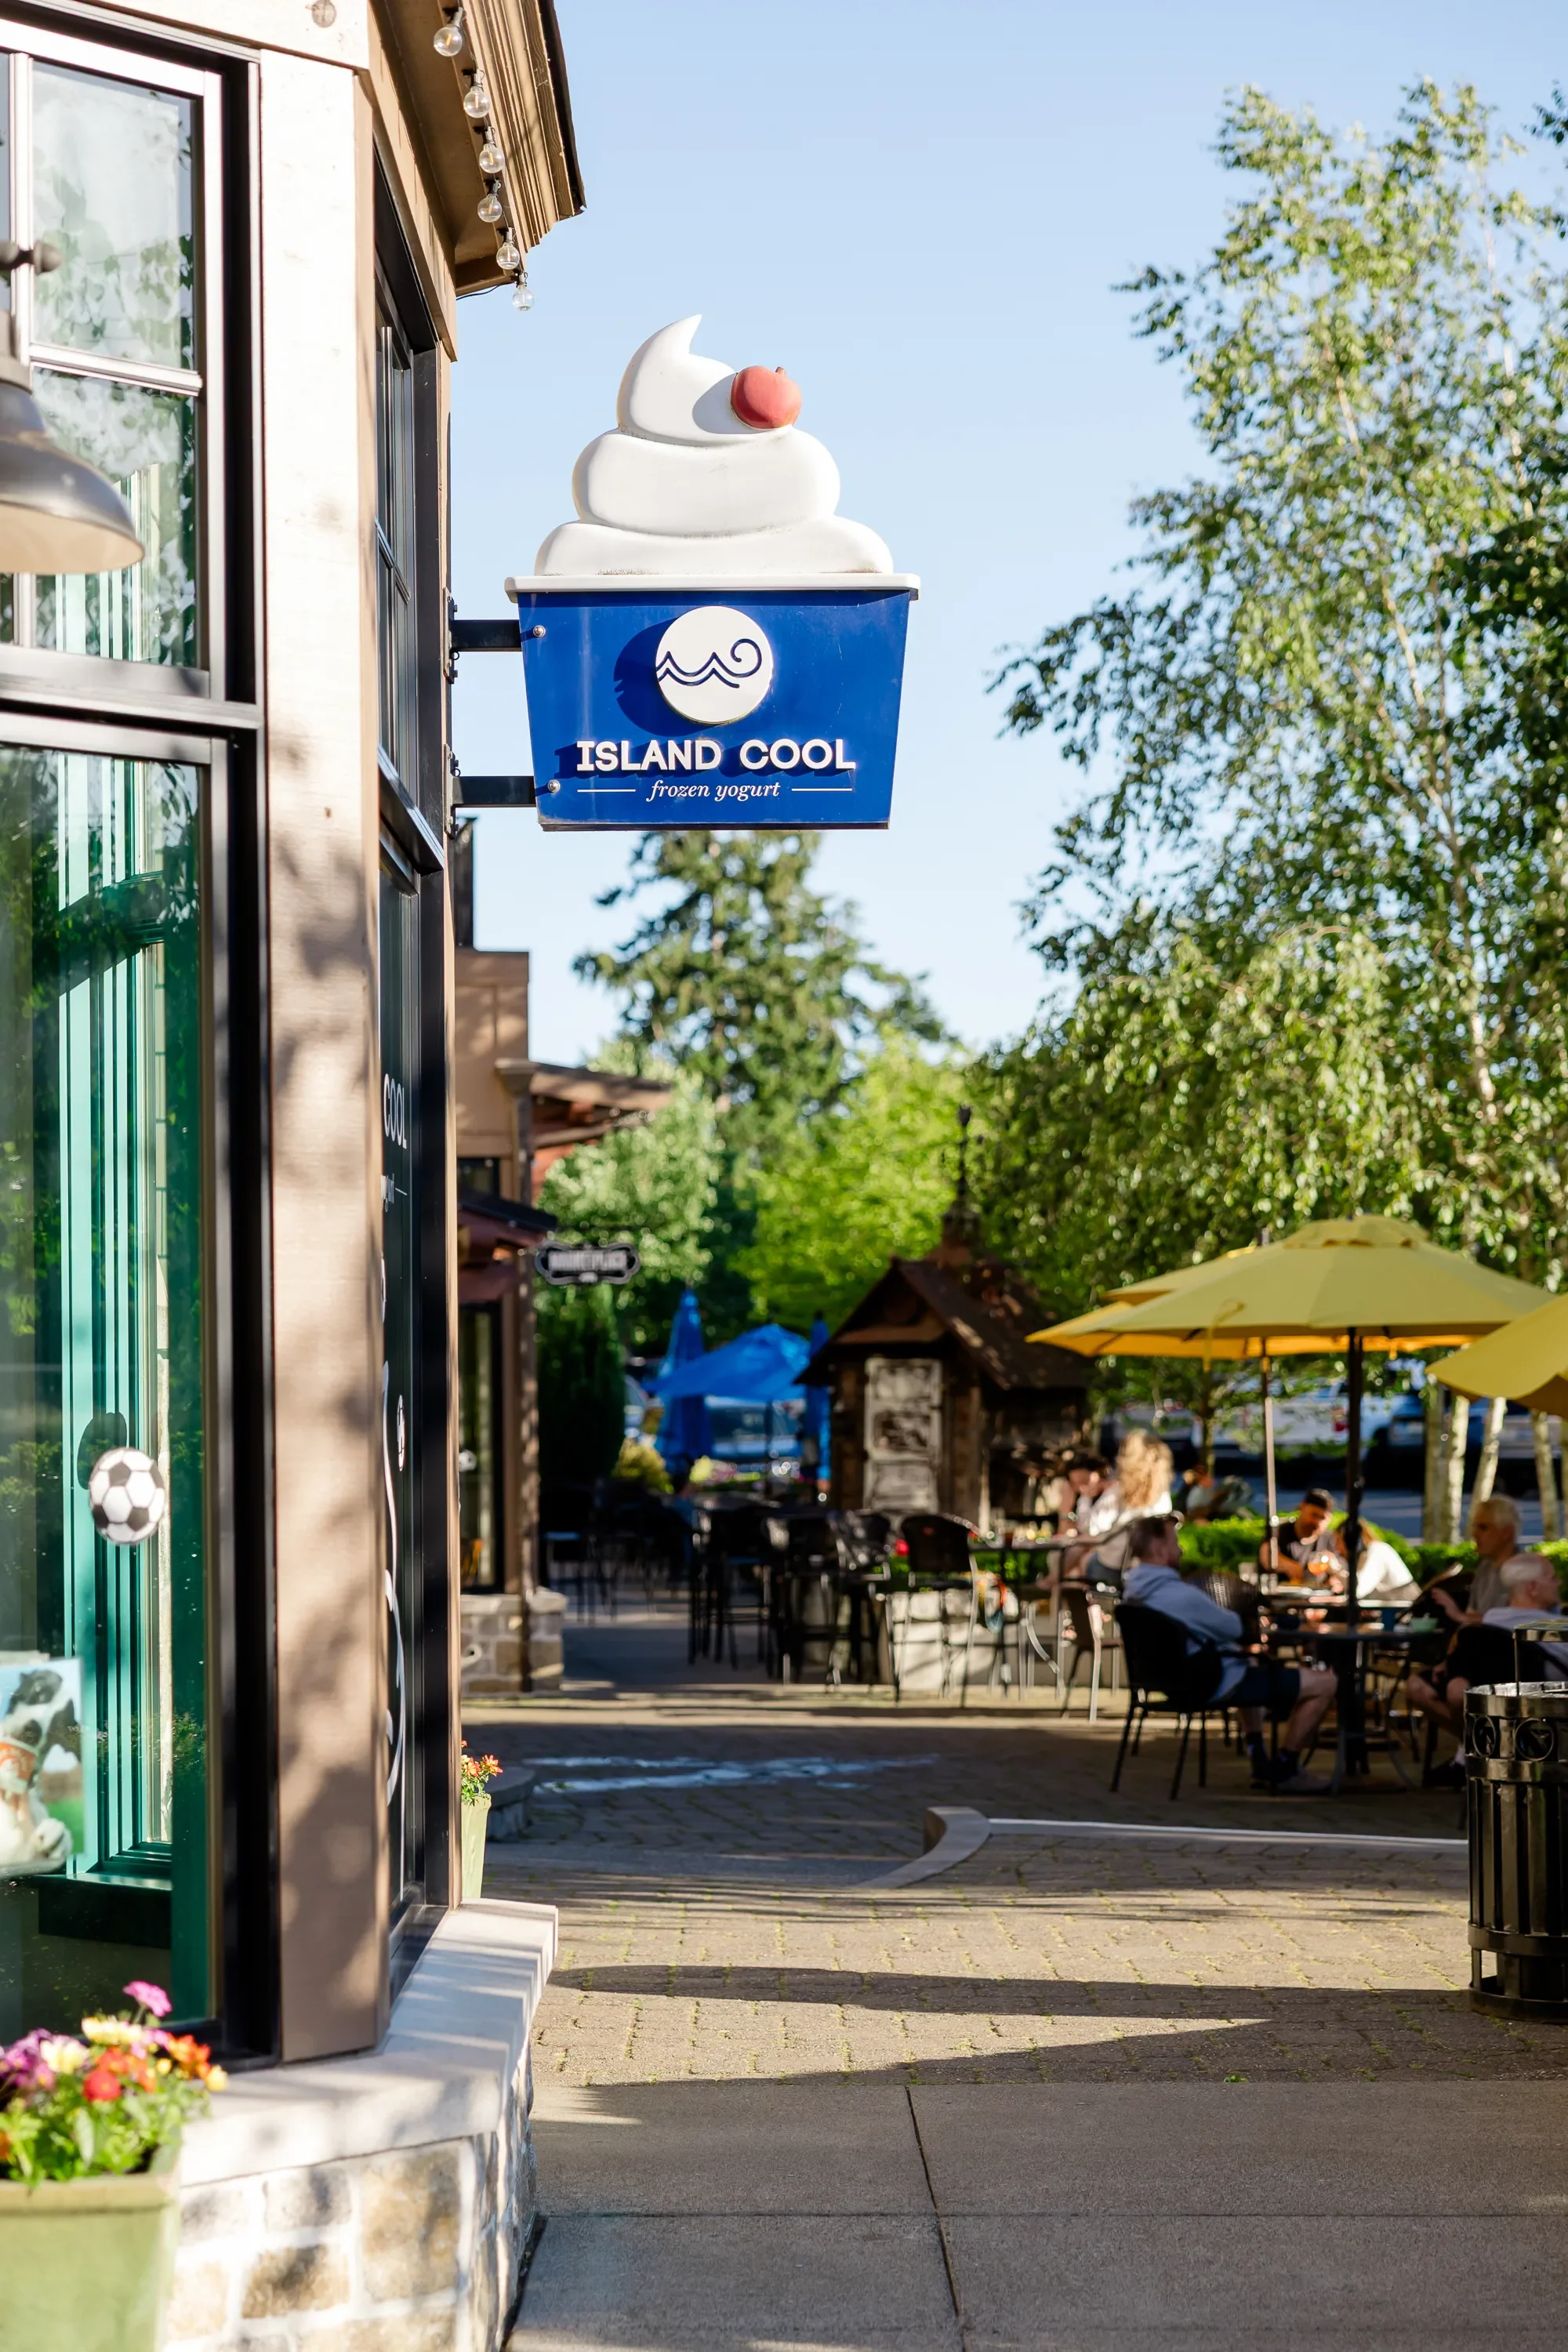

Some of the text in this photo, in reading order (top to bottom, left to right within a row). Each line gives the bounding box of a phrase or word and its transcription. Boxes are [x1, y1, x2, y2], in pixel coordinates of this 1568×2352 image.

[576, 738, 857, 771] ISLAND COOL
[645, 779, 782, 803] frozen yogurt
[383, 1073, 407, 1149] COOL
